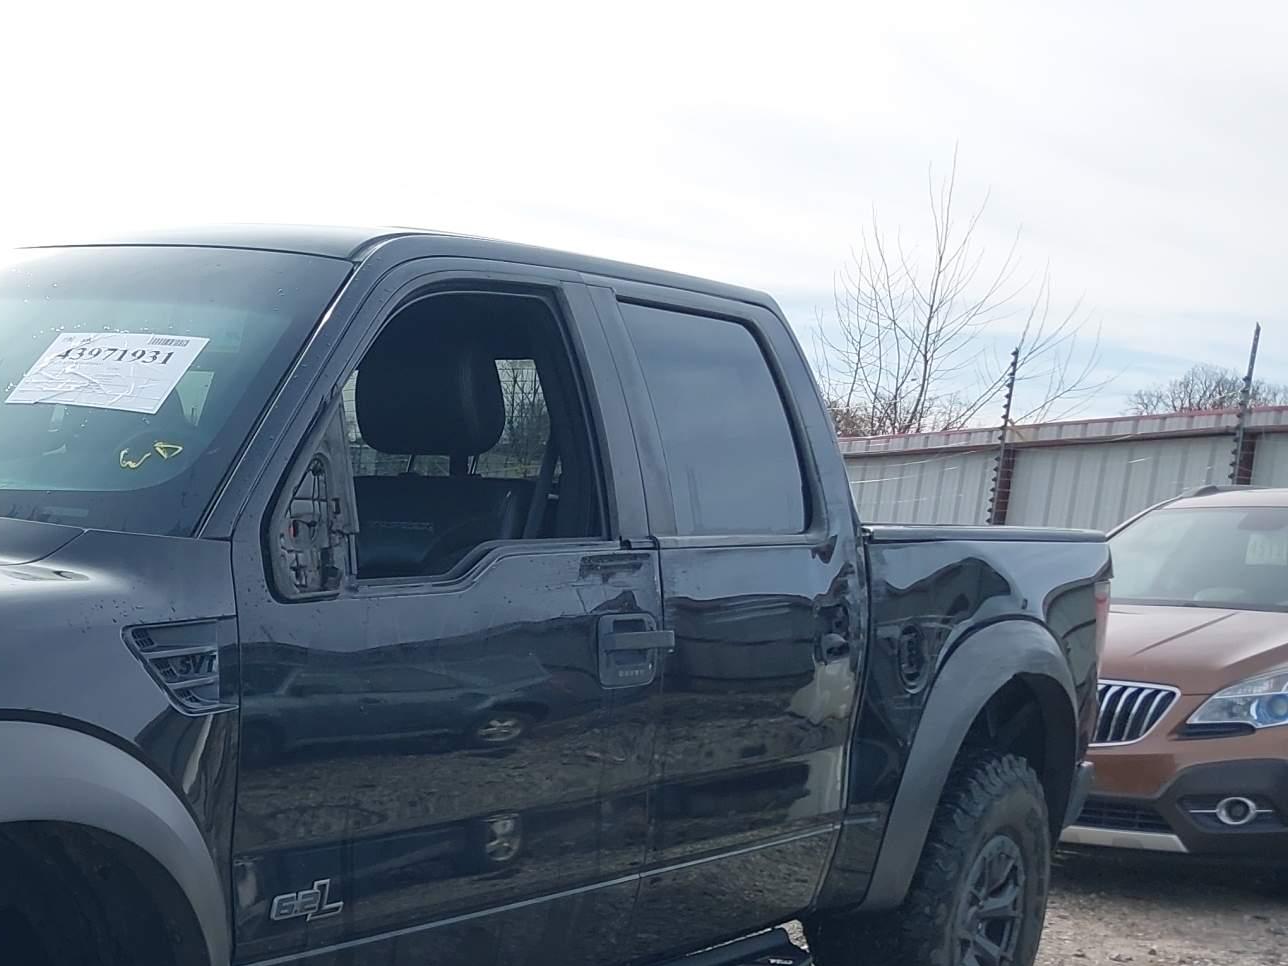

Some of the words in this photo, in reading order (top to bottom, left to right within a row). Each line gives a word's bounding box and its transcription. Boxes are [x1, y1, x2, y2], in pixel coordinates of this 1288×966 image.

[55, 346, 175, 365] 43971931
[179, 652, 217, 675] SVT
[270, 878, 344, 922] 6.2L
